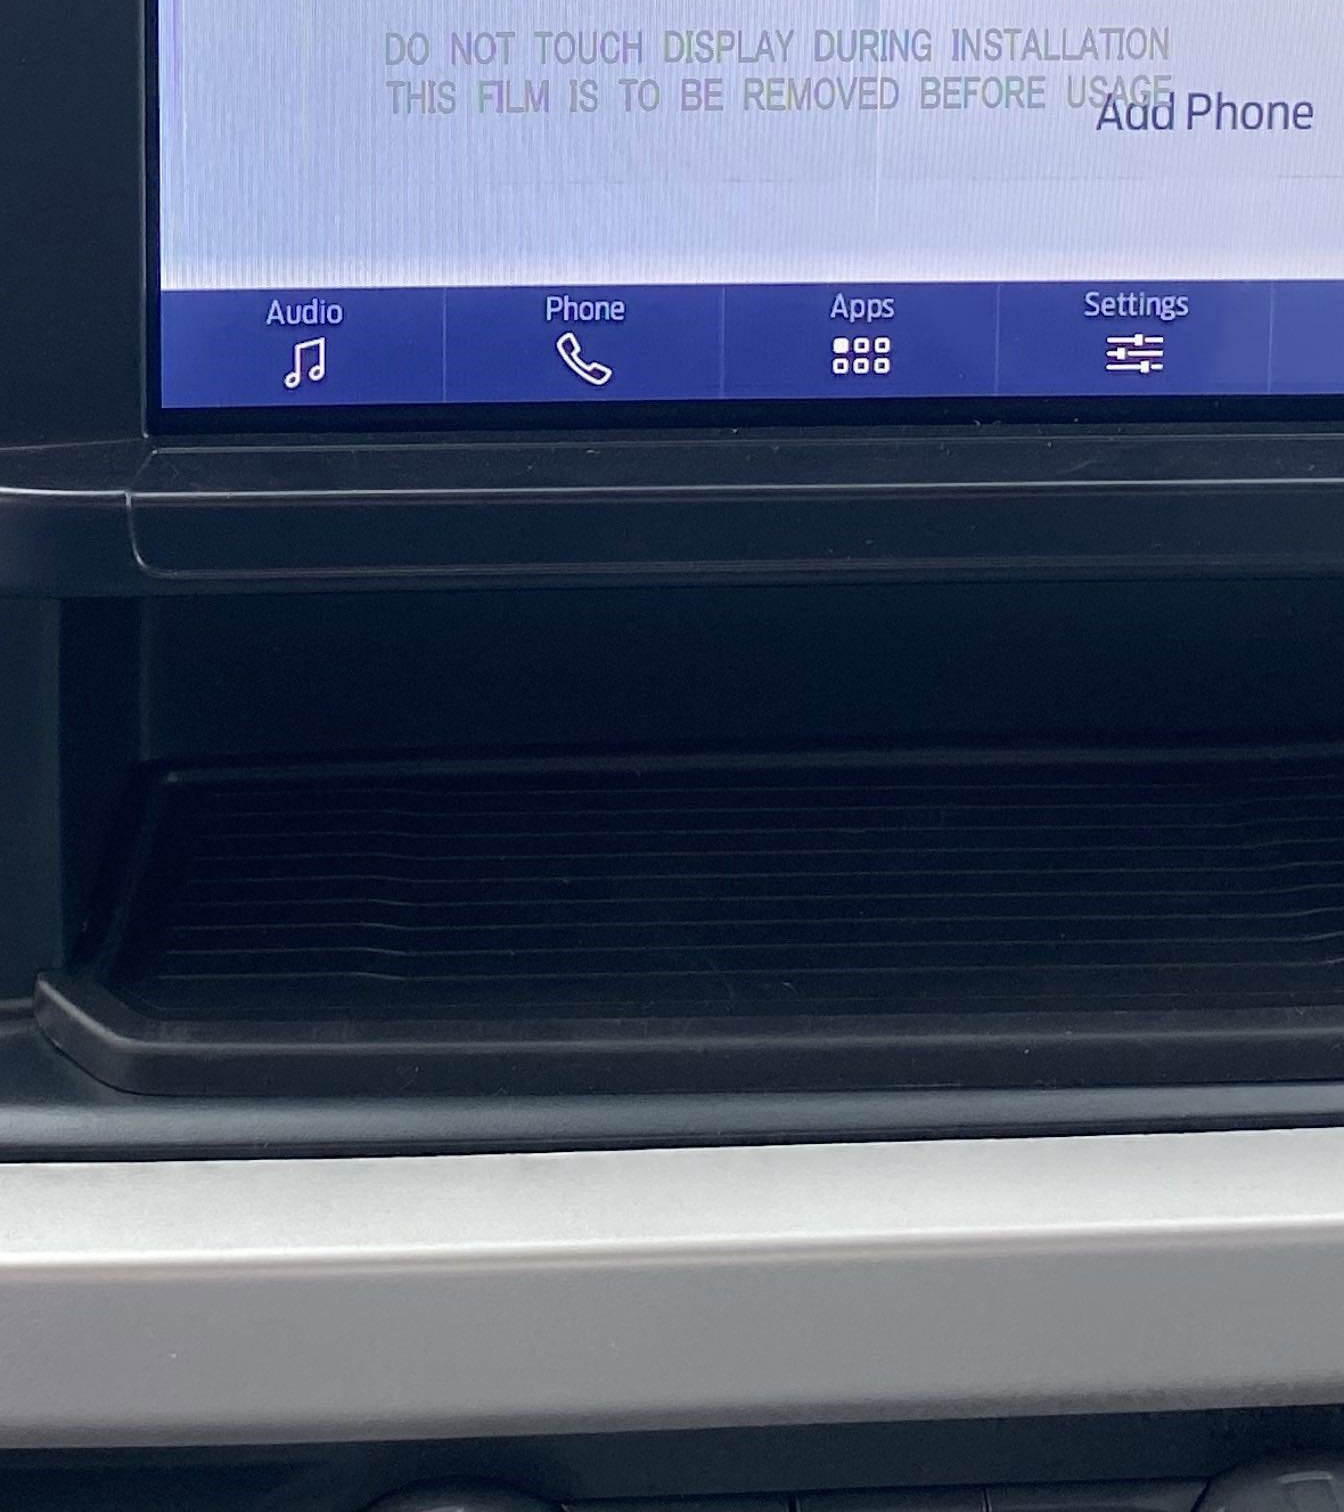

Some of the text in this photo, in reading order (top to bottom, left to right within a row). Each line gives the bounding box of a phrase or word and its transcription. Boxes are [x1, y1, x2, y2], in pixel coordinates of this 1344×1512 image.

[385, 26, 1169, 65] DO NOT TOUCH DISPLAY DURING INSTALLATION
[386, 74, 1172, 114] THIS FILM IS TO BE REMOVED BEFORE USAGE
[1096, 91, 1314, 130] Add Phone
[266, 298, 344, 325] Audio
[546, 295, 625, 321] Phone
[830, 293, 895, 322] Apps
[1084, 291, 1189, 321] Settings
